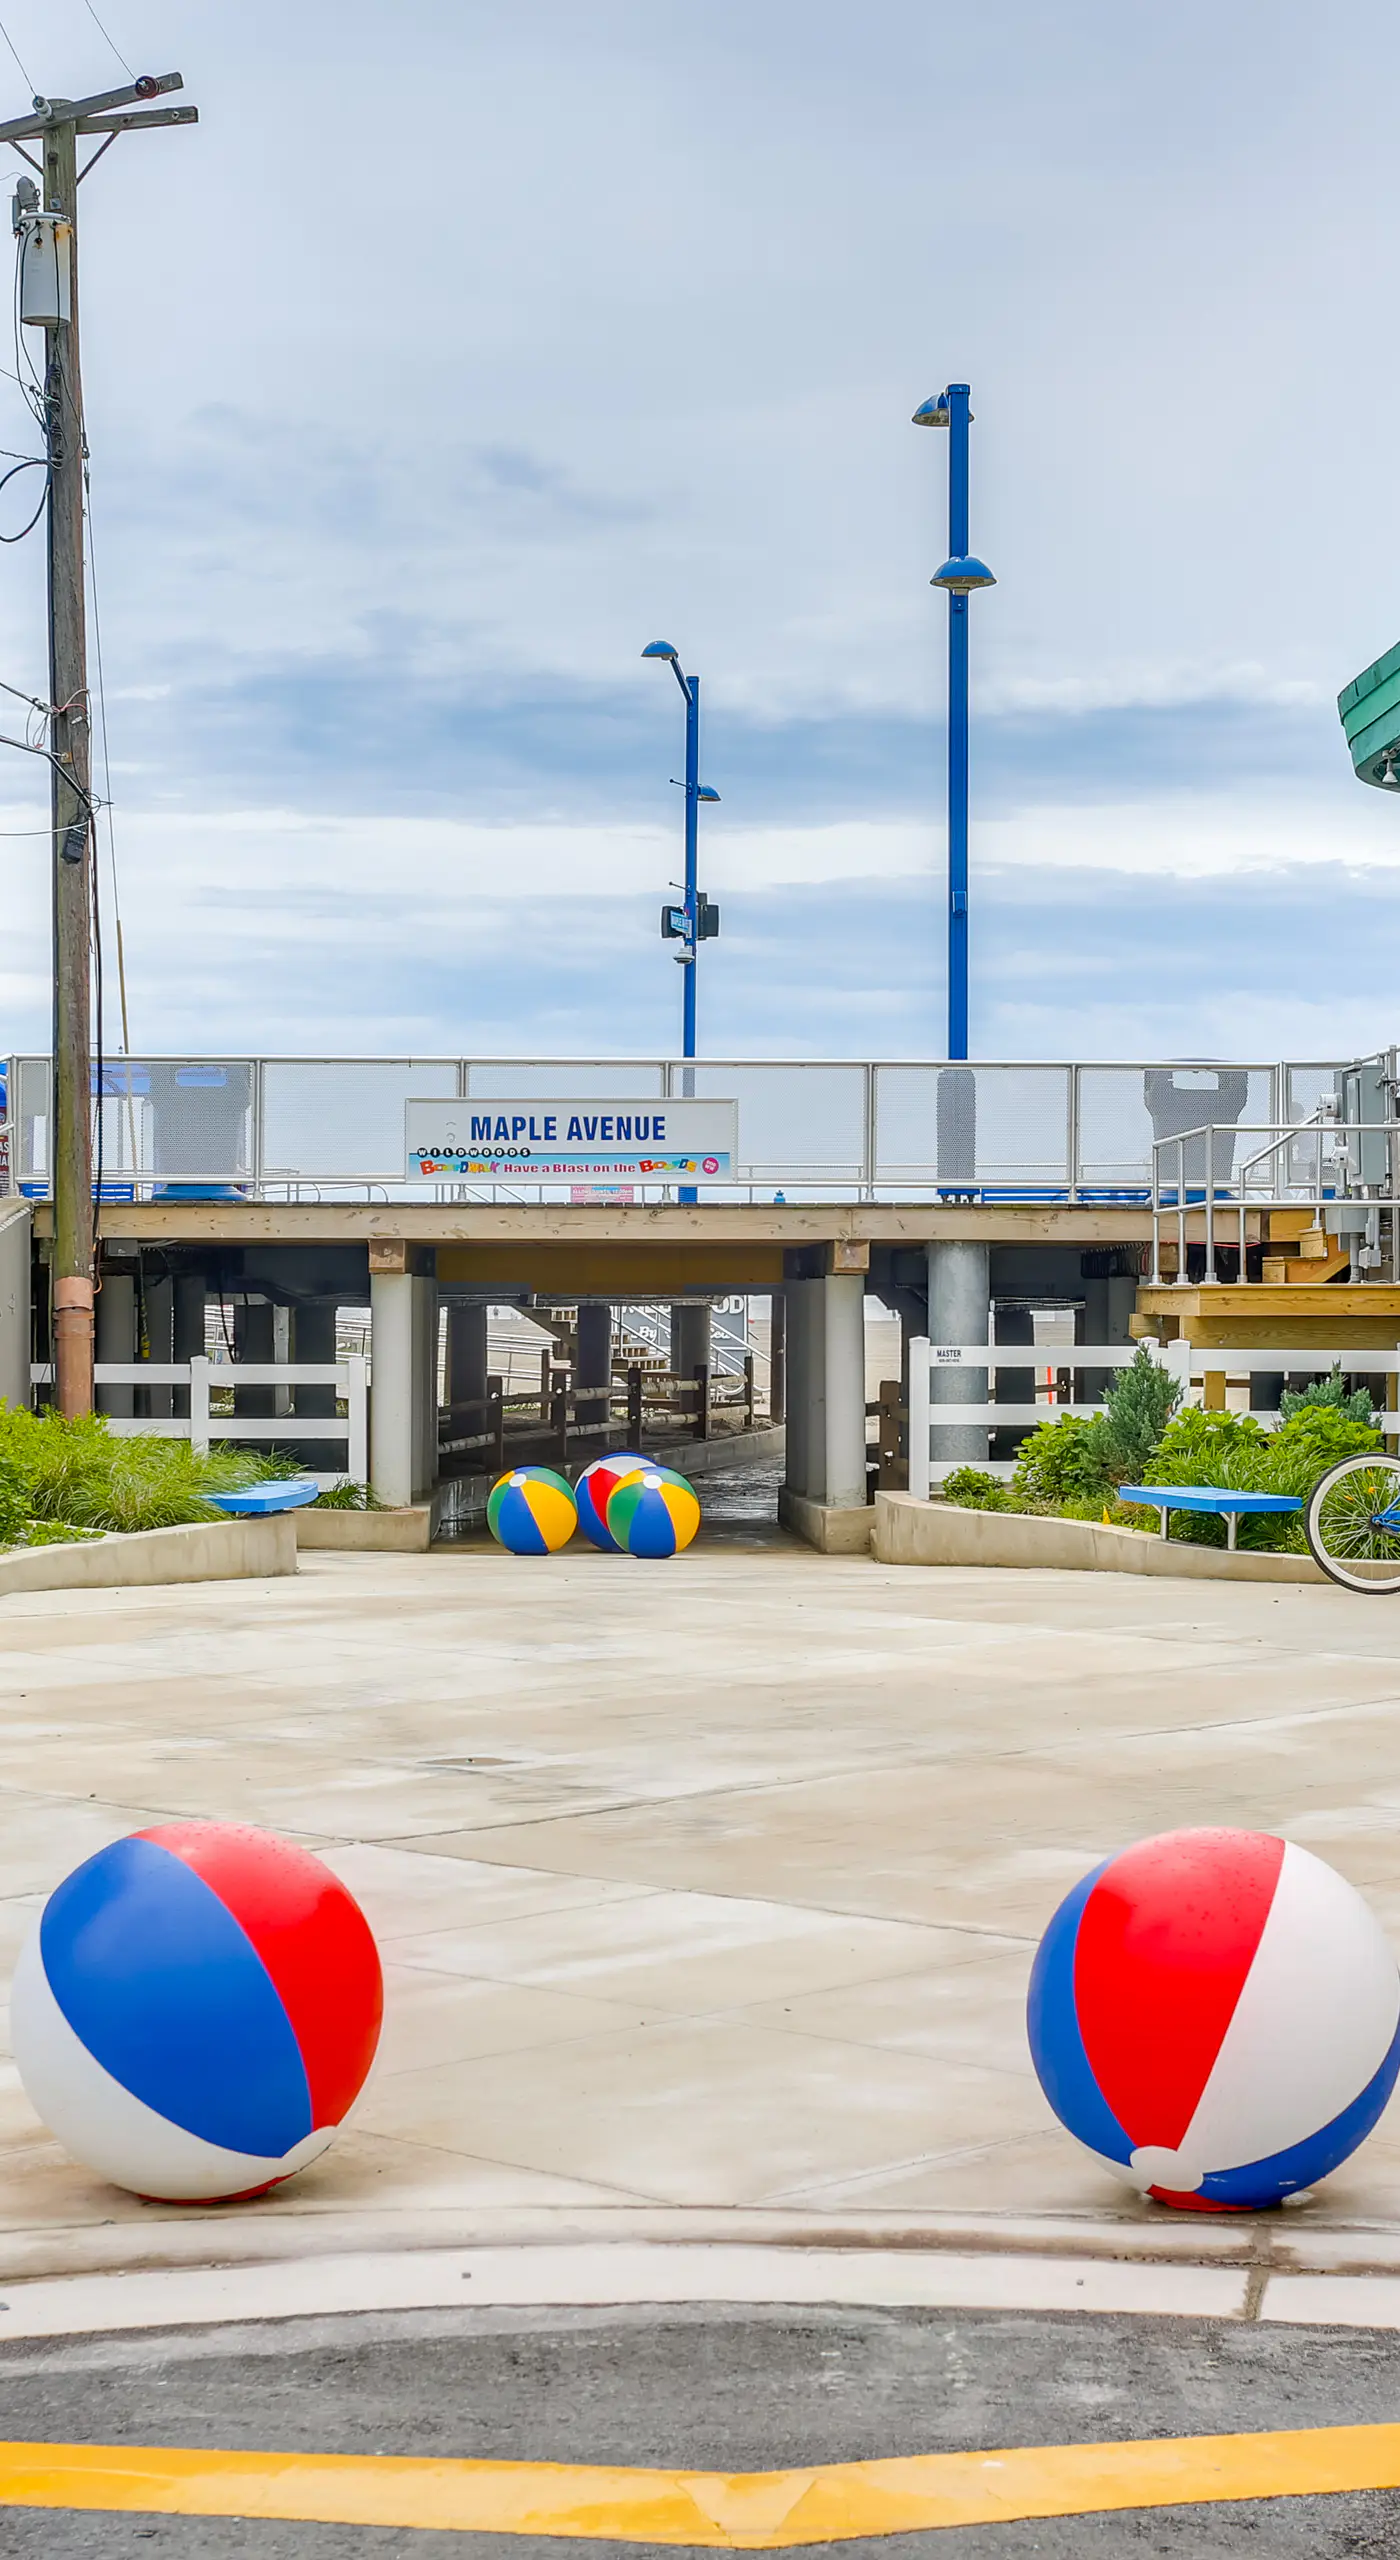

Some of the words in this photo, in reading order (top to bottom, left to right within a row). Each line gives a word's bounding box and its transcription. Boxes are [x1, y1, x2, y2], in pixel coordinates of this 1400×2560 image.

[471, 1116, 557, 1140] MAPLE
[567, 1116, 665, 1140] AVENUE
[417, 1147, 531, 1158] WILDWOODS
[504, 1164, 538, 1173] Have
[542, 1164, 550, 1173] a
[553, 1163, 590, 1173] Blast
[593, 1164, 610, 1173] on
[614, 1163, 636, 1173] the
[936, 1349, 962, 1357] MASTER
